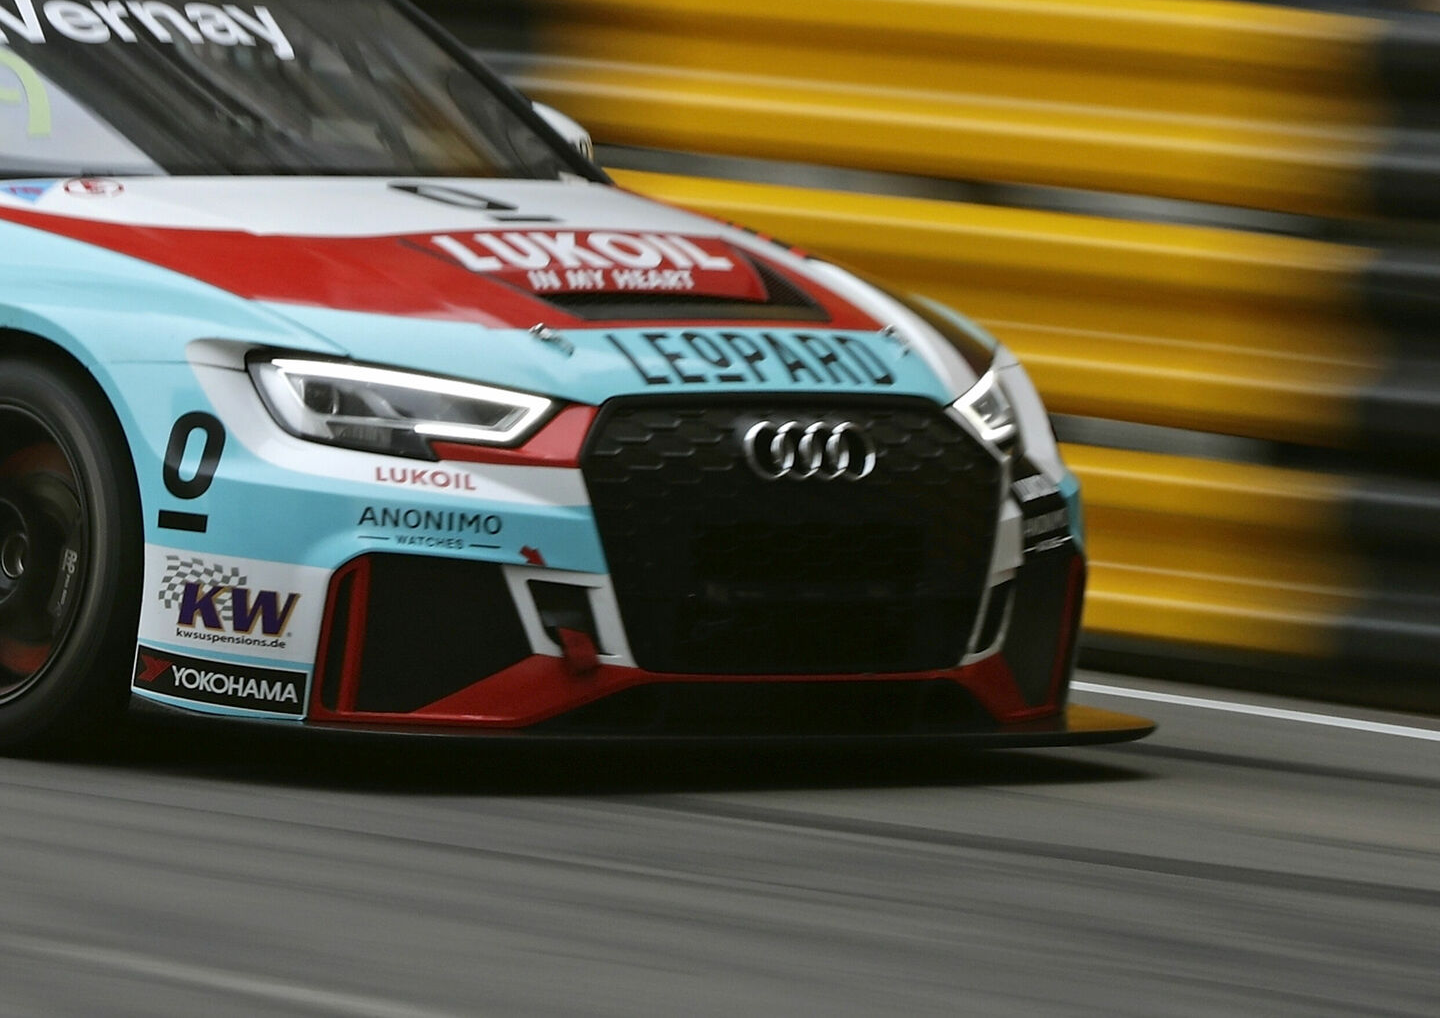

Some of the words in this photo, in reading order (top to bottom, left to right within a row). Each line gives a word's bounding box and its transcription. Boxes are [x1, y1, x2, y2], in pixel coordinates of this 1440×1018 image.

[431, 232, 734, 272] LUKOIL
[527, 268, 561, 291] IN
[566, 269, 605, 291] MY
[612, 269, 696, 291] HEART
[606, 330, 898, 386] LEOPARD
[375, 466, 477, 491] LUKOIL
[357, 505, 503, 535] ANONIMO
[396, 533, 465, 550] WATCHES
[176, 581, 302, 639] KW
[176, 626, 287, 650] kwsuspensions.de
[171, 664, 299, 704] YOKOHAMA
